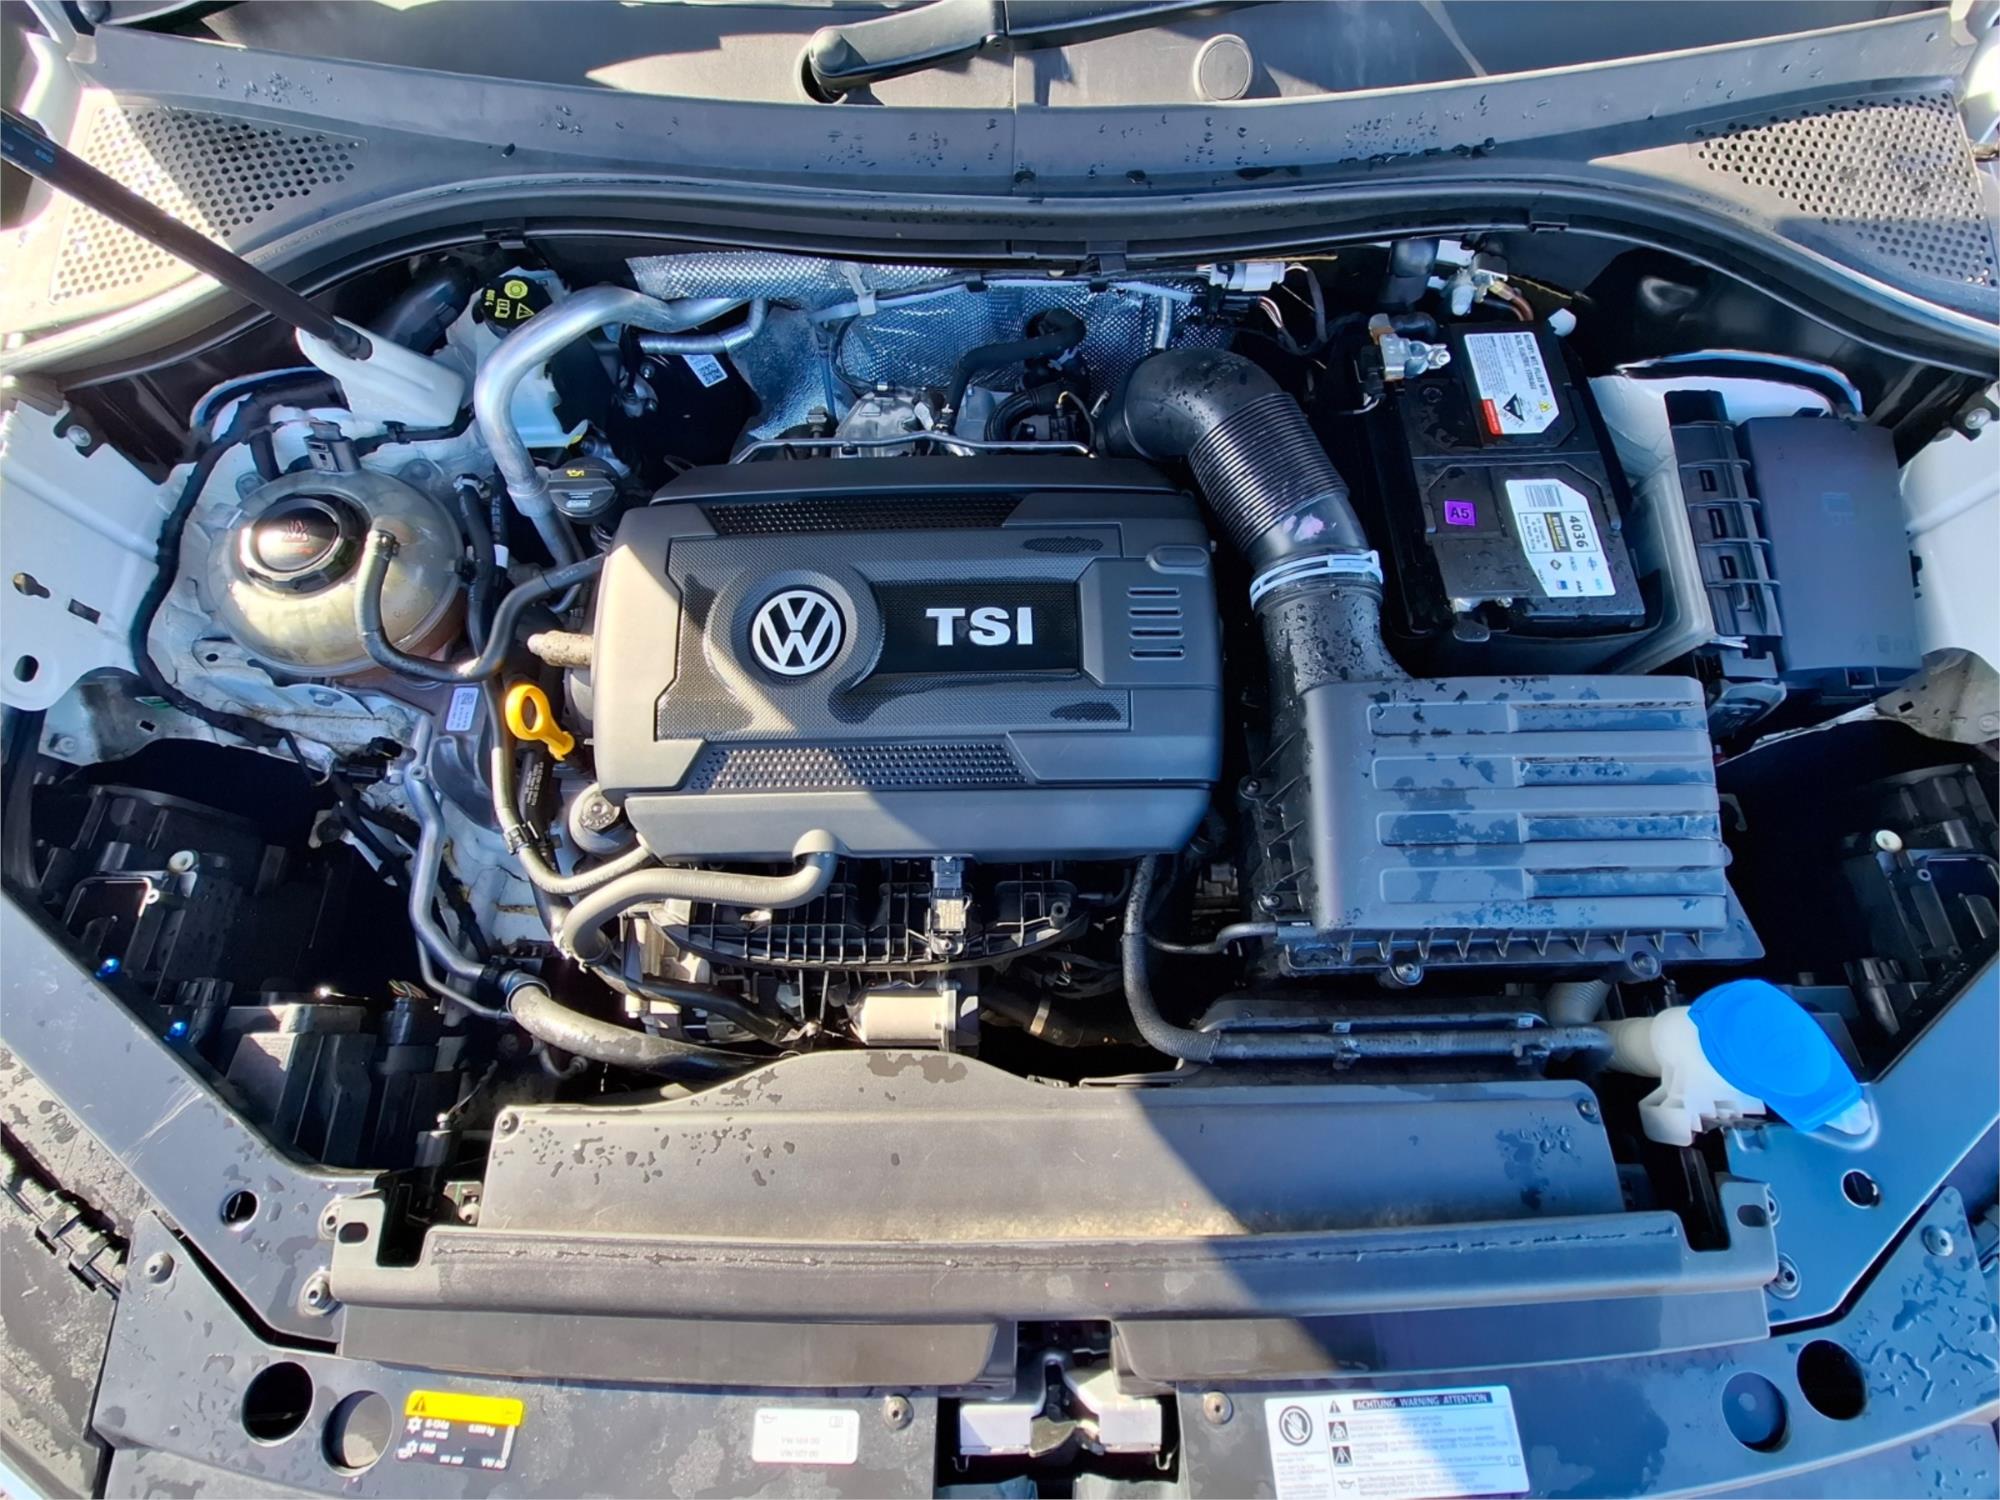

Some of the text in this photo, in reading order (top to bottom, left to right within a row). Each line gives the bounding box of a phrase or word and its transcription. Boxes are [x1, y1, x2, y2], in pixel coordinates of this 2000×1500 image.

[1451, 507, 1470, 519] A5
[1569, 515, 1589, 548] 4036
[925, 606, 1034, 647] TSI
[1356, 1393, 1488, 1410] ACHTUNG WARNING ATTENTION
